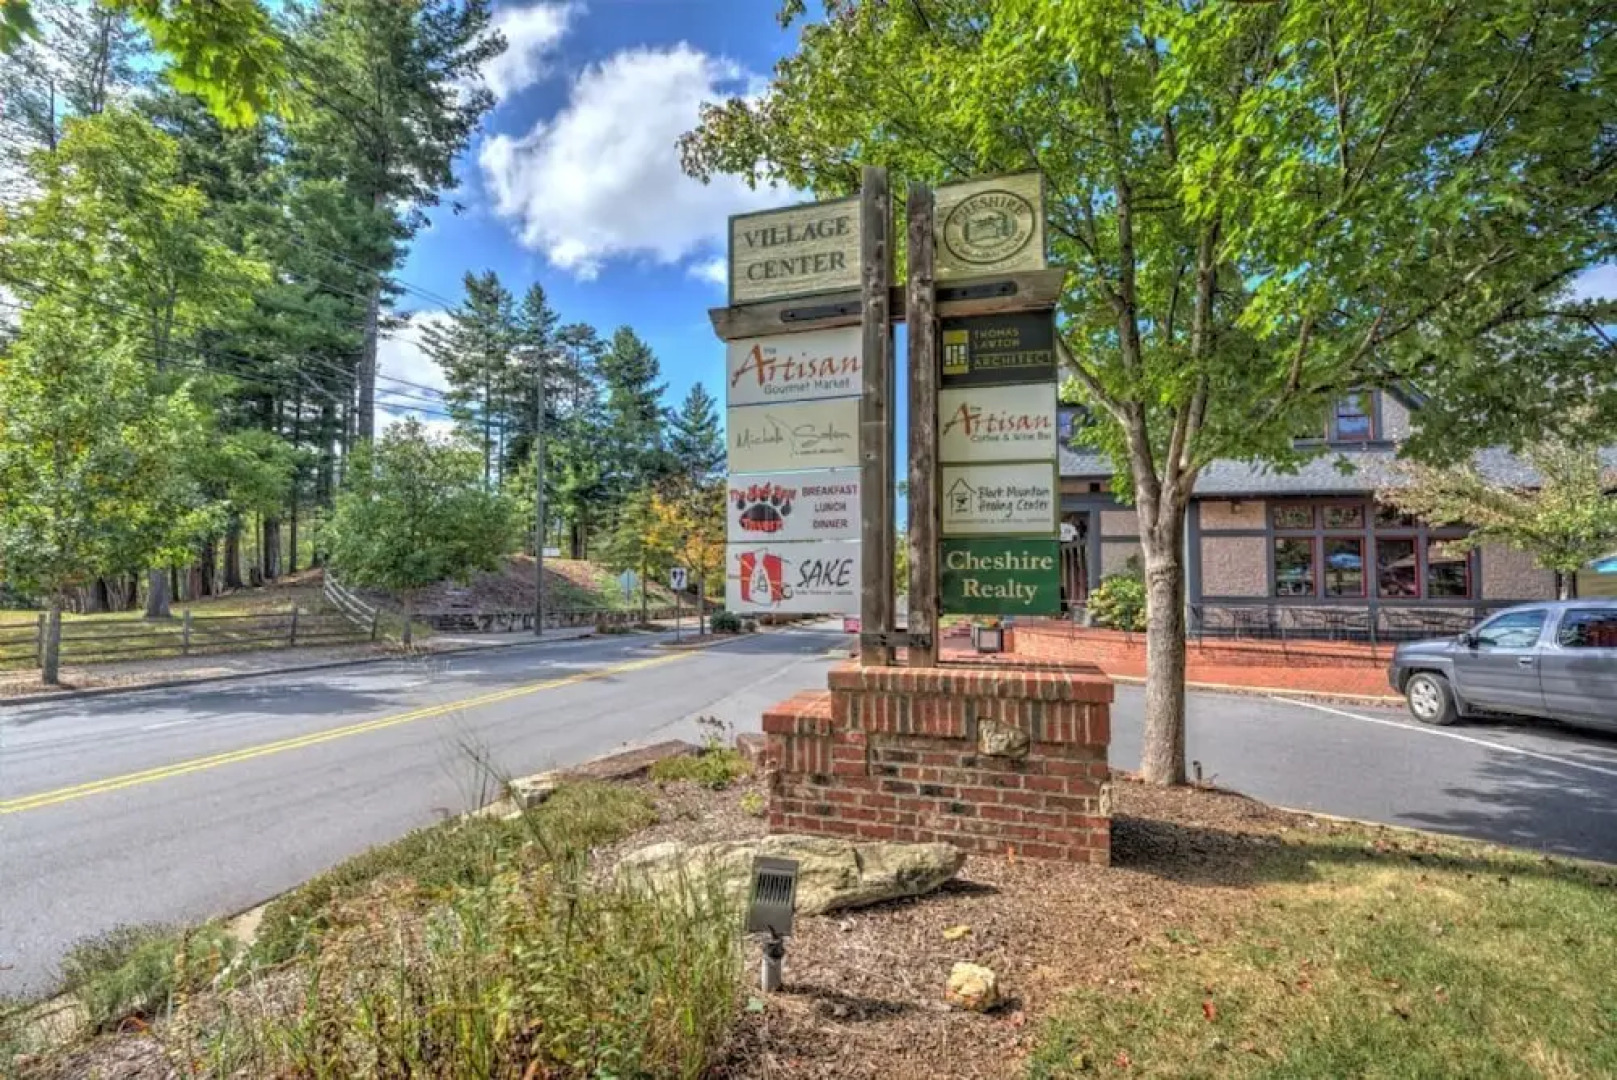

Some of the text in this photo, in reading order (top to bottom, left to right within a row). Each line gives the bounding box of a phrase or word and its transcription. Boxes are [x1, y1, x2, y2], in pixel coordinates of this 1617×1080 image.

[744, 216, 850, 248] VILLAGE
[747, 251, 846, 281] CENTER
[731, 344, 861, 388] Artisan
[764, 377, 850, 395] Gourmet Market
[942, 402, 1051, 436] Artisan
[801, 484, 858, 498] BREAKFAST
[814, 502, 847, 513] LUNCH
[812, 519, 848, 530] DINNER
[797, 558, 854, 588] SAKE
[946, 550, 1054, 570] Cheshire
[961, 578, 1038, 605] Realty
